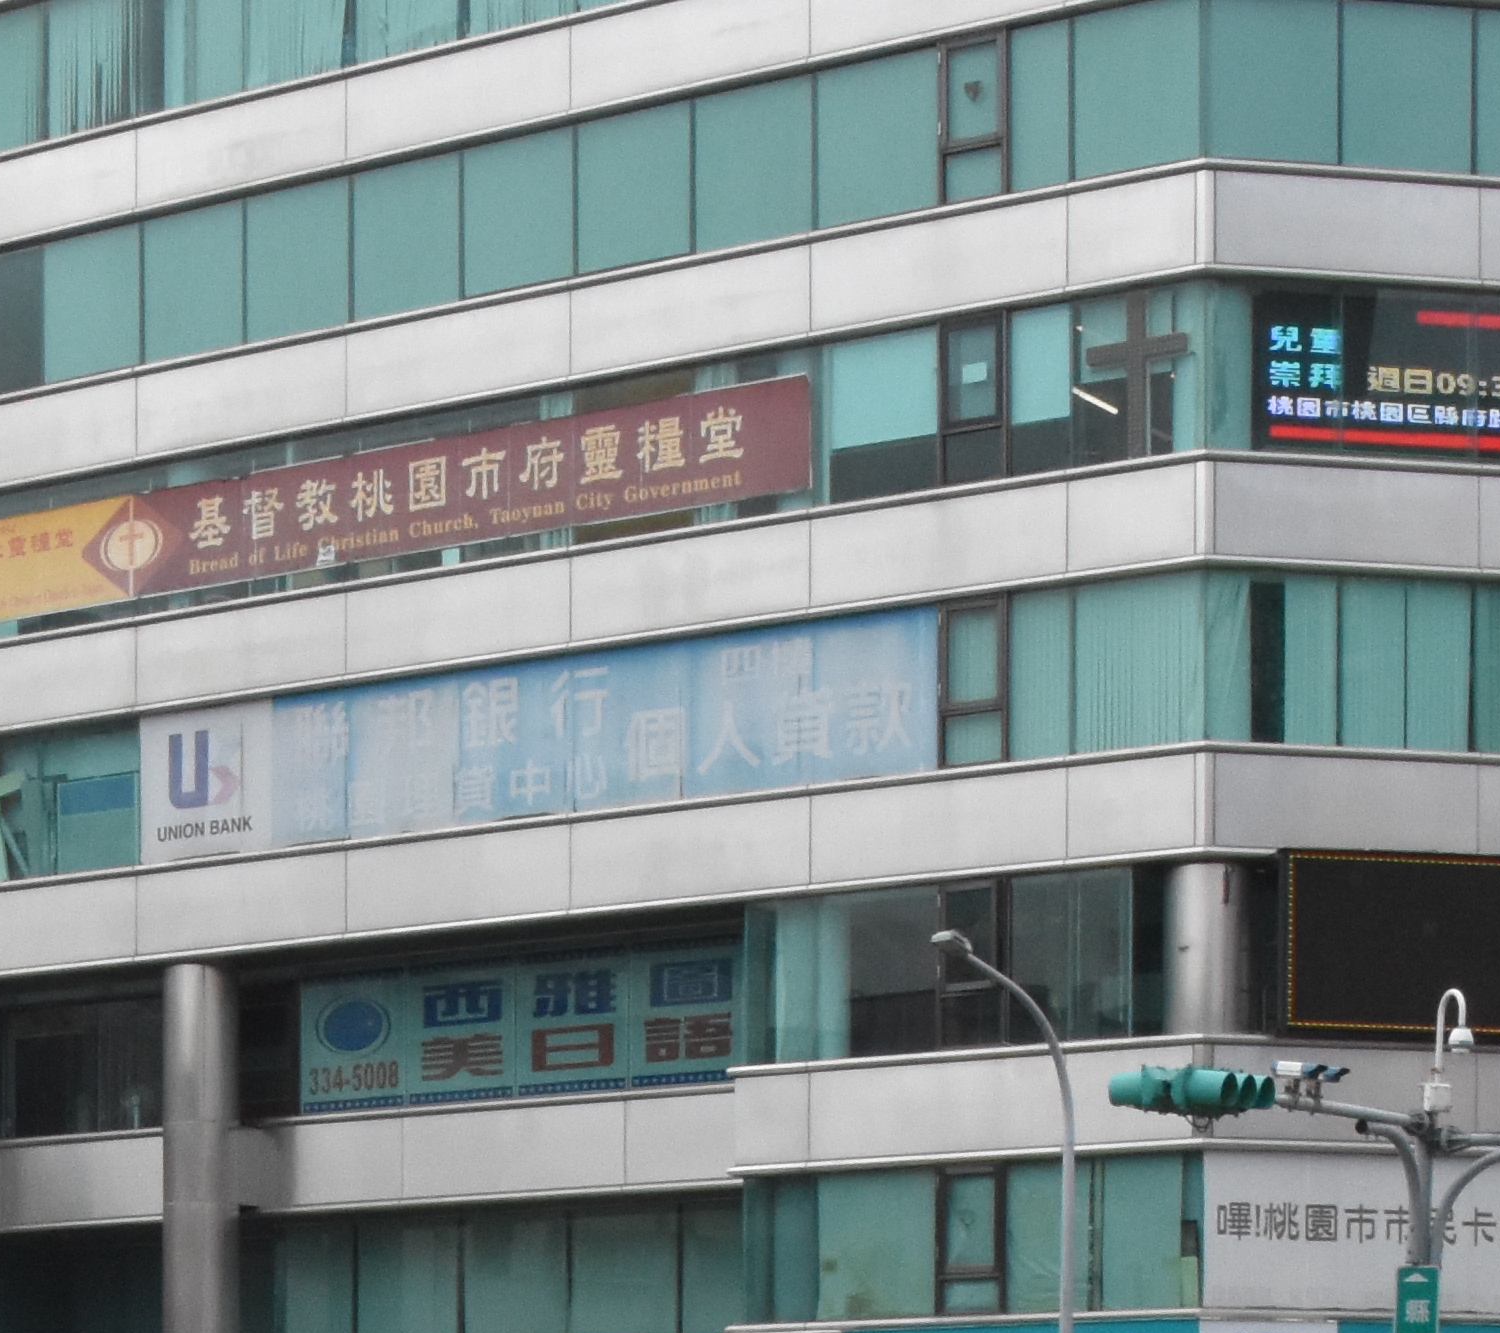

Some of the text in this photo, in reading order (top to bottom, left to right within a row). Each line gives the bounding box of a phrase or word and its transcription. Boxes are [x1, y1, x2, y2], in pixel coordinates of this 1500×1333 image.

[1268, 325, 1342, 355] 兒童
[1268, 361, 1342, 391] 崇拜
[189, 406, 744, 548] 基督教桃園市府靈糧堂
[188, 553, 239, 575] Bread
[248, 548, 265, 565] of
[274, 543, 308, 561] Life
[317, 527, 399, 553] Christian
[490, 501, 565, 525] Taoyuan
[576, 491, 613, 511] City
[624, 470, 742, 503] Government
[157, 815, 253, 843] UNION BANK
[309, 1061, 399, 1095] 334-5008
